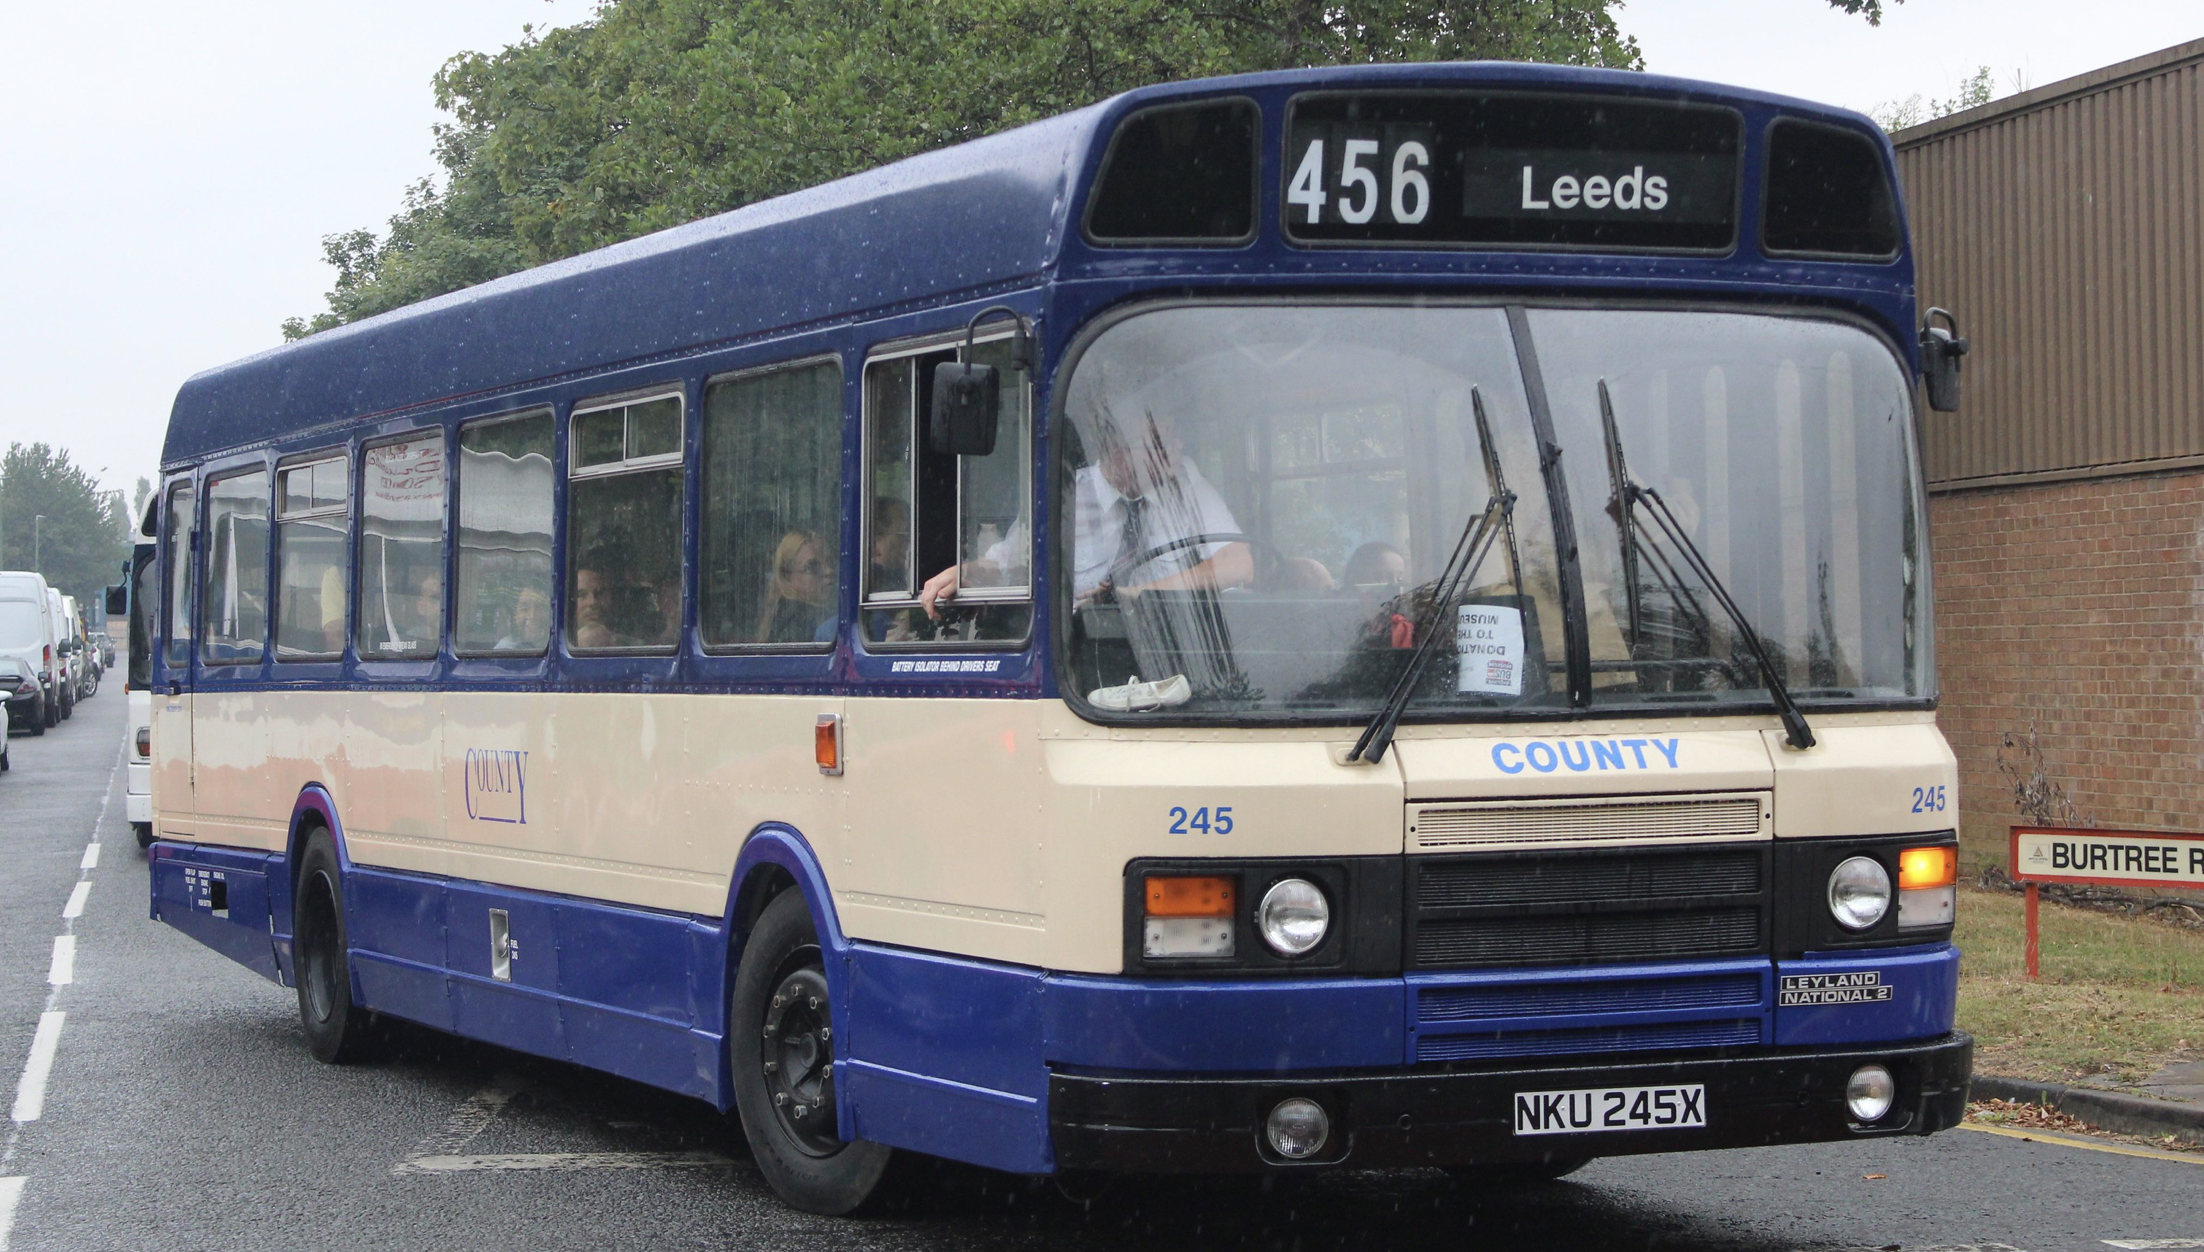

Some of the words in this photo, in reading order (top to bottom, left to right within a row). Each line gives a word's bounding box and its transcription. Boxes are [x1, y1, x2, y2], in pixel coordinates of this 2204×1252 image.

[1287, 139, 1430, 224] 456
[1521, 165, 1668, 210] Leeds
[1460, 614, 1499, 625] MUSEU
[1476, 629, 1494, 639] TO
[891, 660, 915, 672] BATTERY
[914, 660, 940, 672] ISOLATOR
[940, 660, 960, 672] BEHIND
[960, 660, 985, 672] DRIVERS
[985, 660, 1000, 672] SEAT
[1495, 669, 1511, 679] BUS
[1491, 738, 1679, 775] COUNTY
[465, 748, 529, 824] COUNTY
[1911, 785, 1946, 814] 245
[1168, 806, 1234, 835] 245
[2052, 842, 2179, 874] BURTREE
[1784, 989, 1873, 1004] NATIONAL
[1877, 988, 1888, 999] 2
[1785, 973, 1877, 990] LEYLAND
[1517, 1092, 1592, 1131] NKU
[1603, 1088, 1702, 1127] 245X
